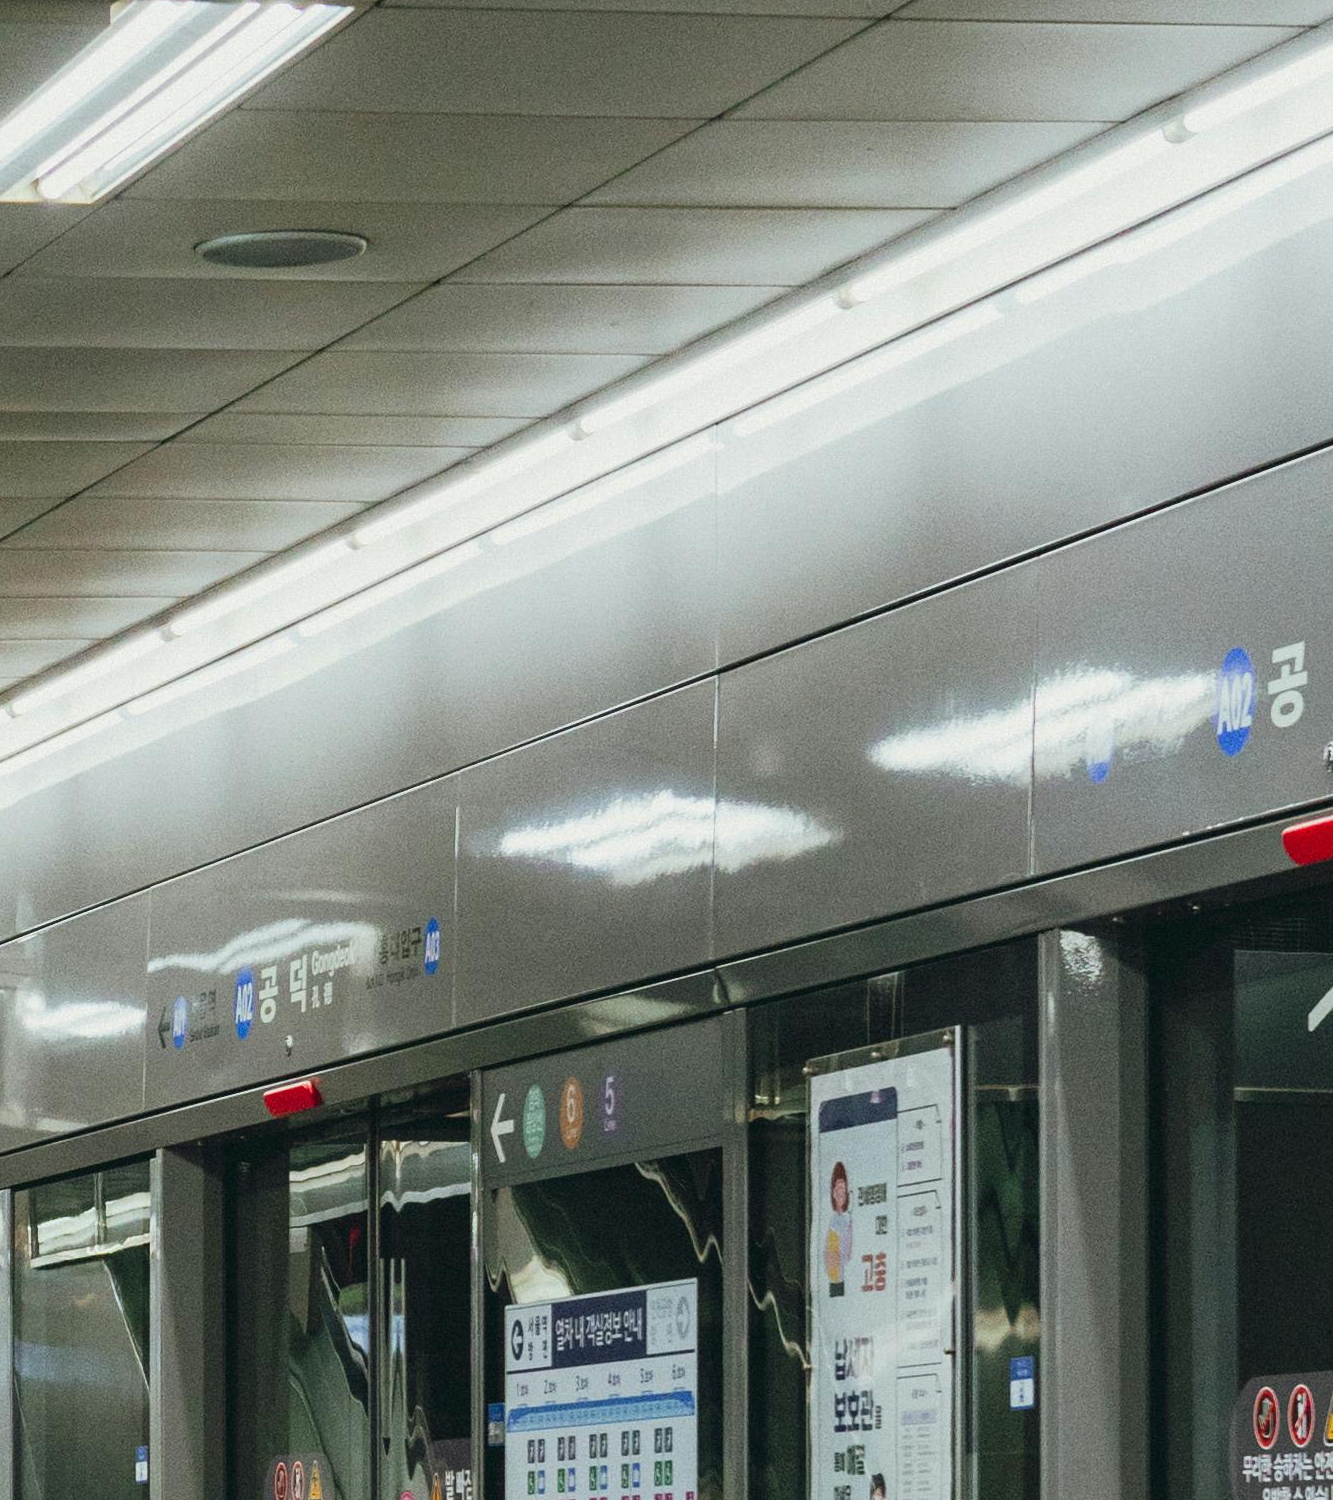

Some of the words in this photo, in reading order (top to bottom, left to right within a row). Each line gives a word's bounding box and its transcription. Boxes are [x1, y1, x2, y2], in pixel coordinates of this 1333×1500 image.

[1217, 671, 1253, 736] A02
[1267, 640, 1308, 729] 공
[235, 982, 253, 1024] A02
[259, 954, 308, 1024] 공덕
[567, 1083, 577, 1124] 6
[605, 1076, 615, 1115] 5
